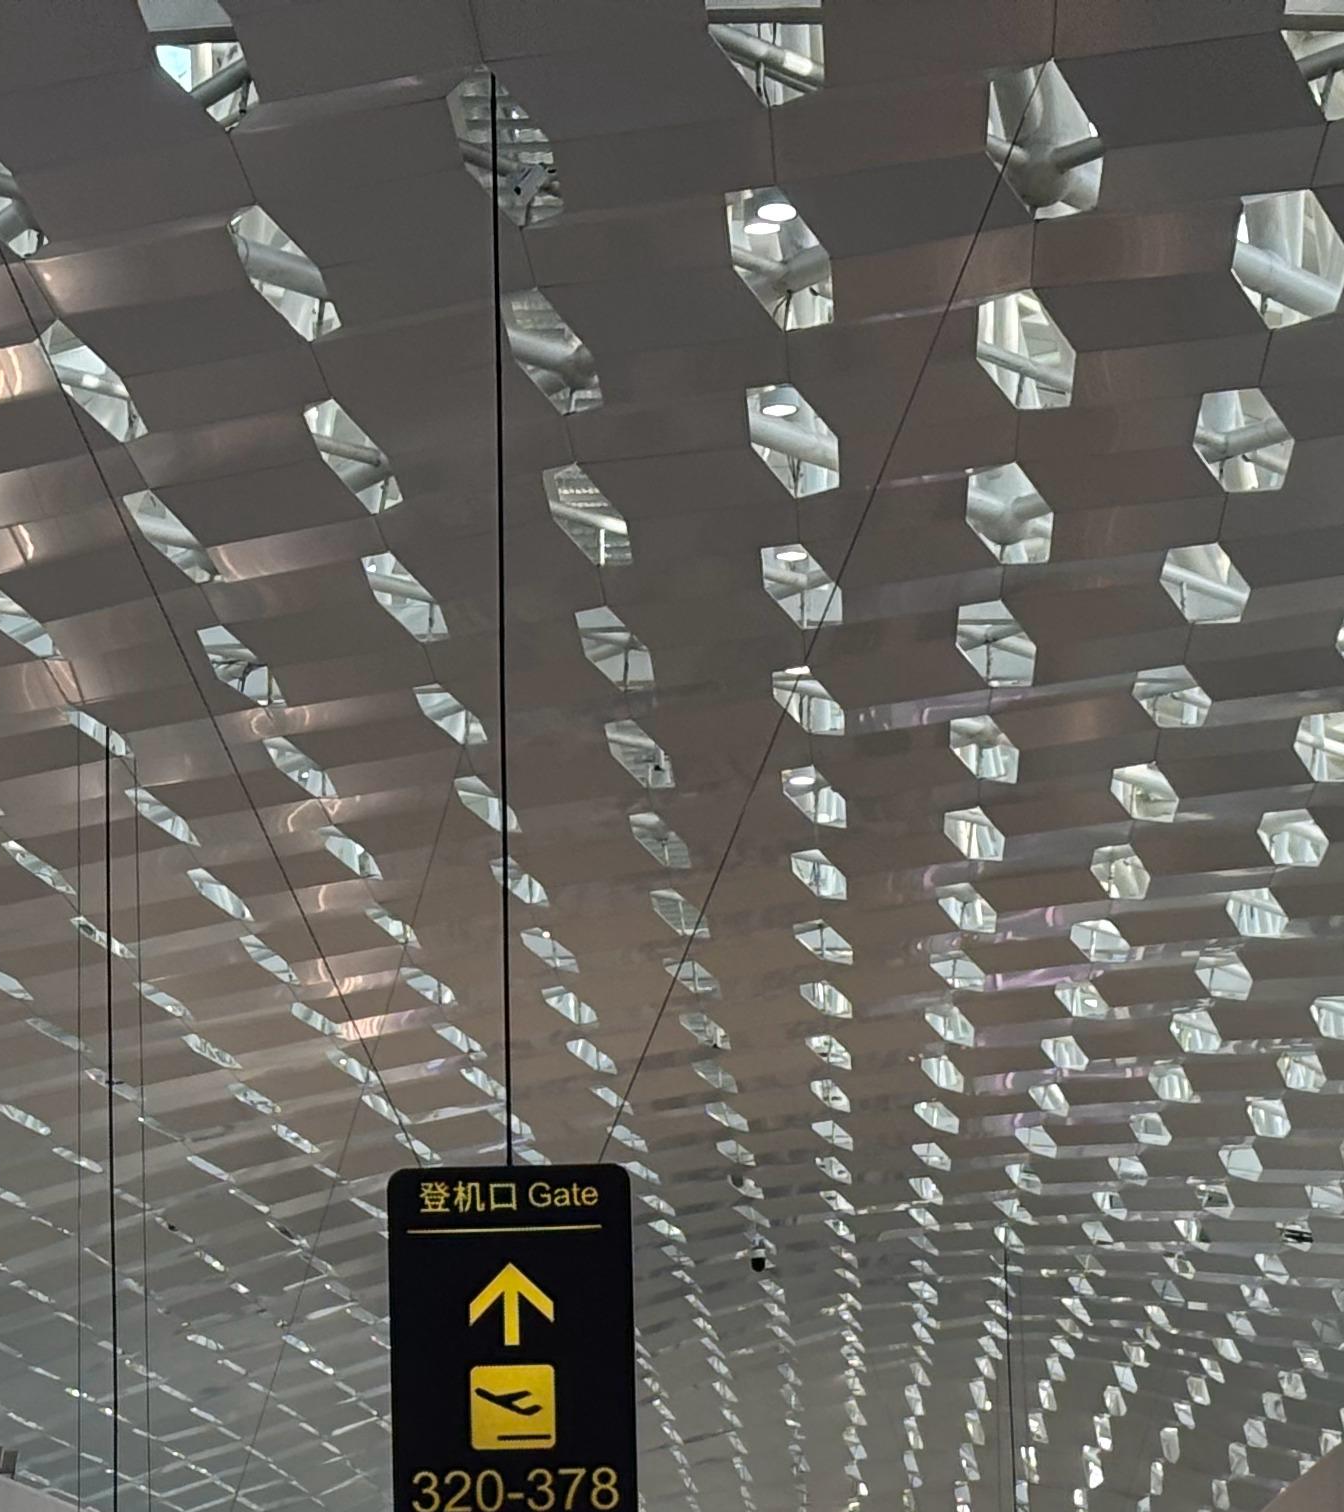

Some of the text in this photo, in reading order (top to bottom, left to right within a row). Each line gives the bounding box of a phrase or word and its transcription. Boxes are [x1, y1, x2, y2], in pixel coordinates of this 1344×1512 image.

[419, 1180, 599, 1213] 登机口 Gate
